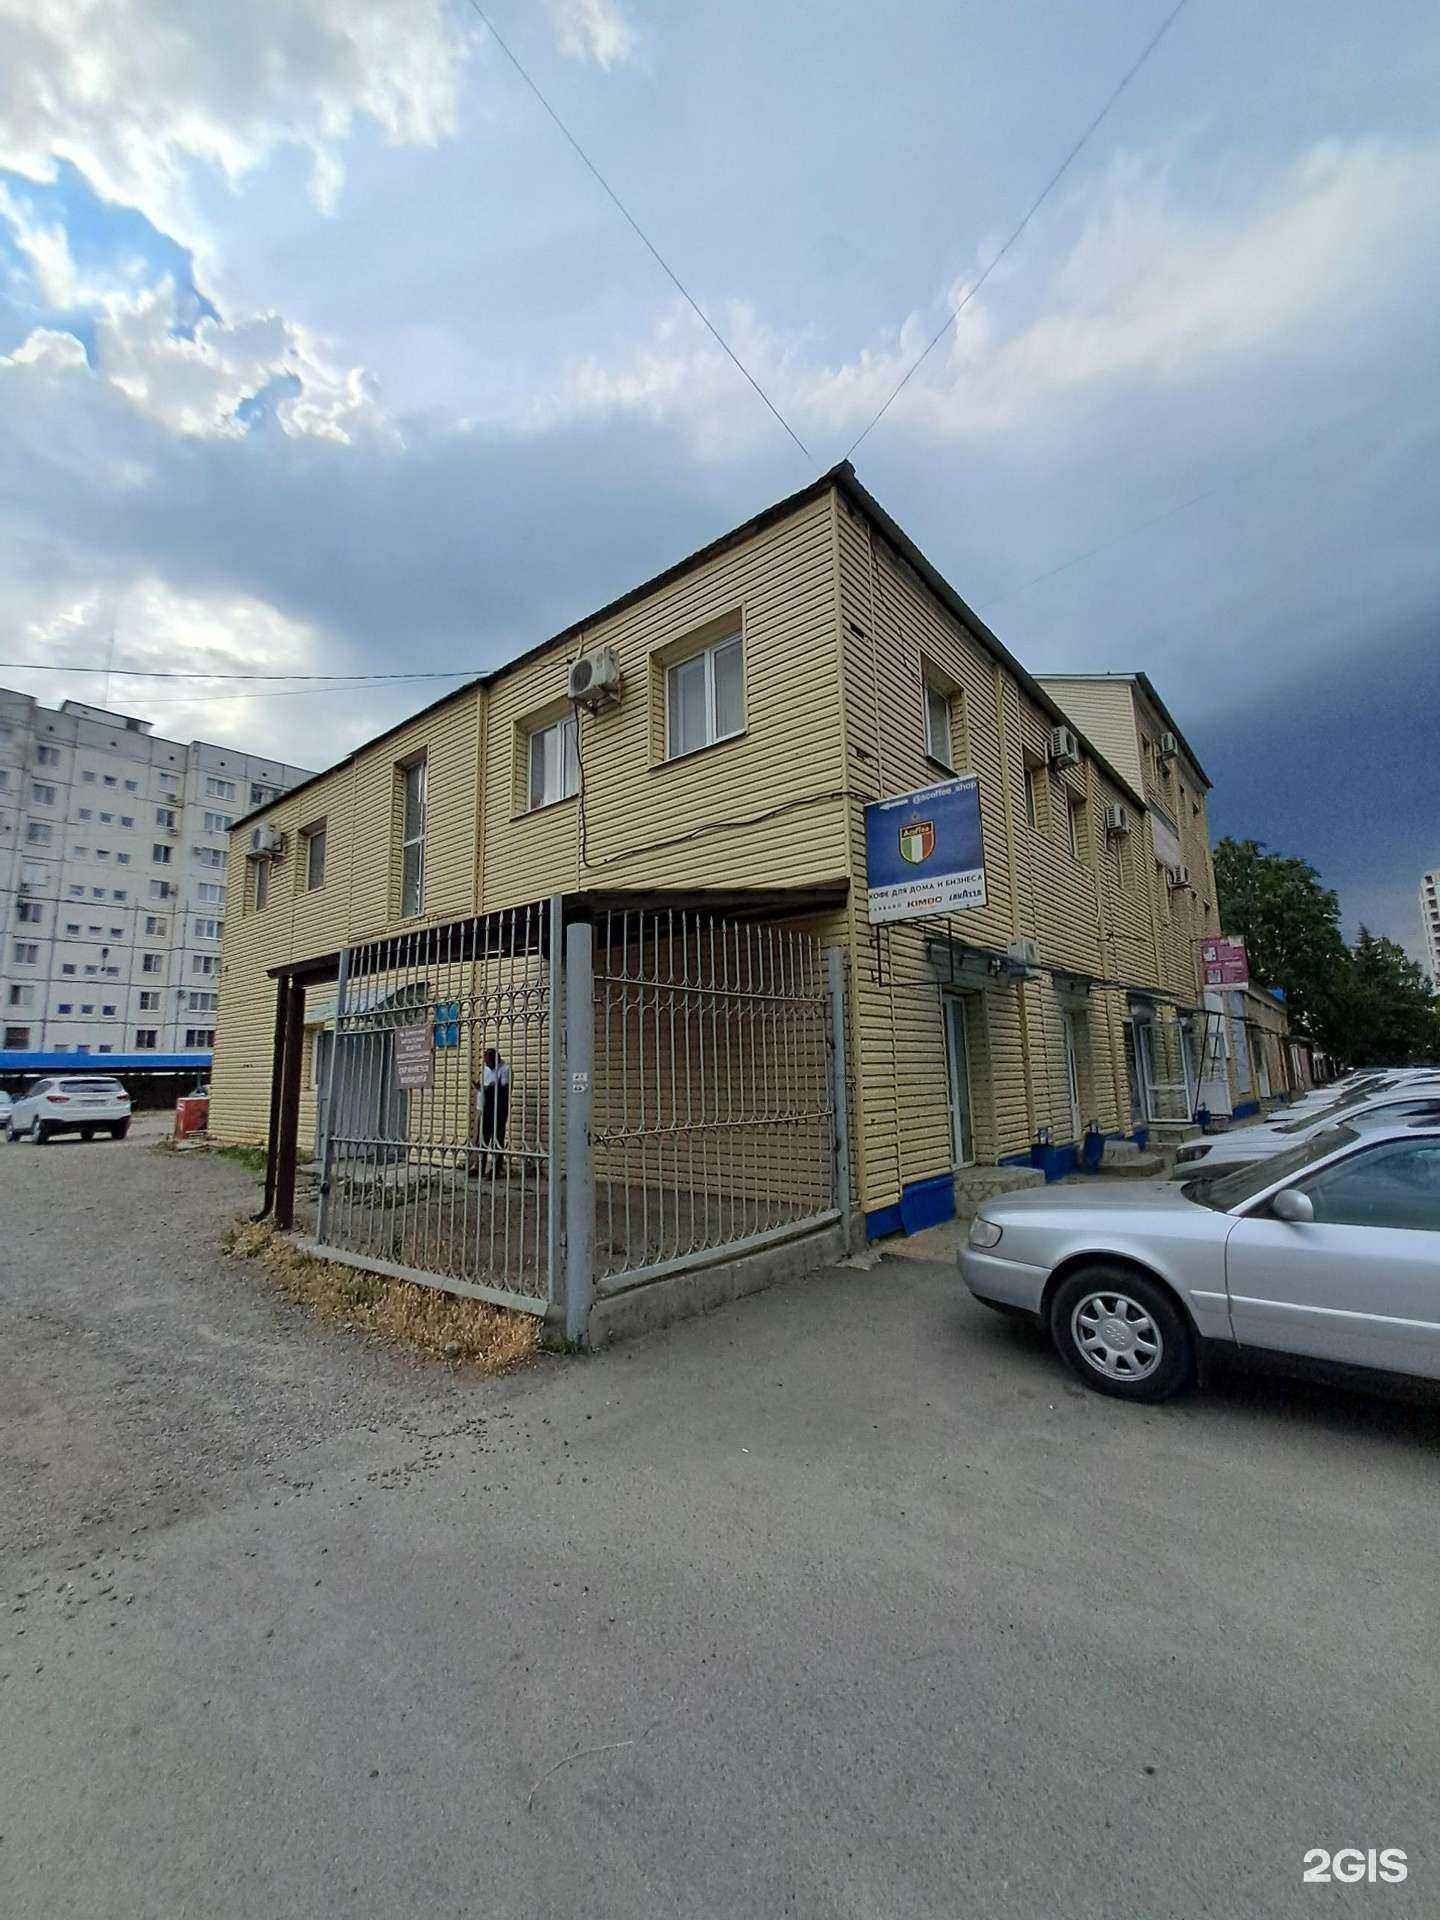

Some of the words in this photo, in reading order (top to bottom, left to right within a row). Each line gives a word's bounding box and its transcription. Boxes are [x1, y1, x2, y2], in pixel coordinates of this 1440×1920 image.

[892, 888, 907, 897] ДЛЯ
[909, 884, 935, 895] ДОМА
[945, 874, 983, 887] БИЗНЕСА
